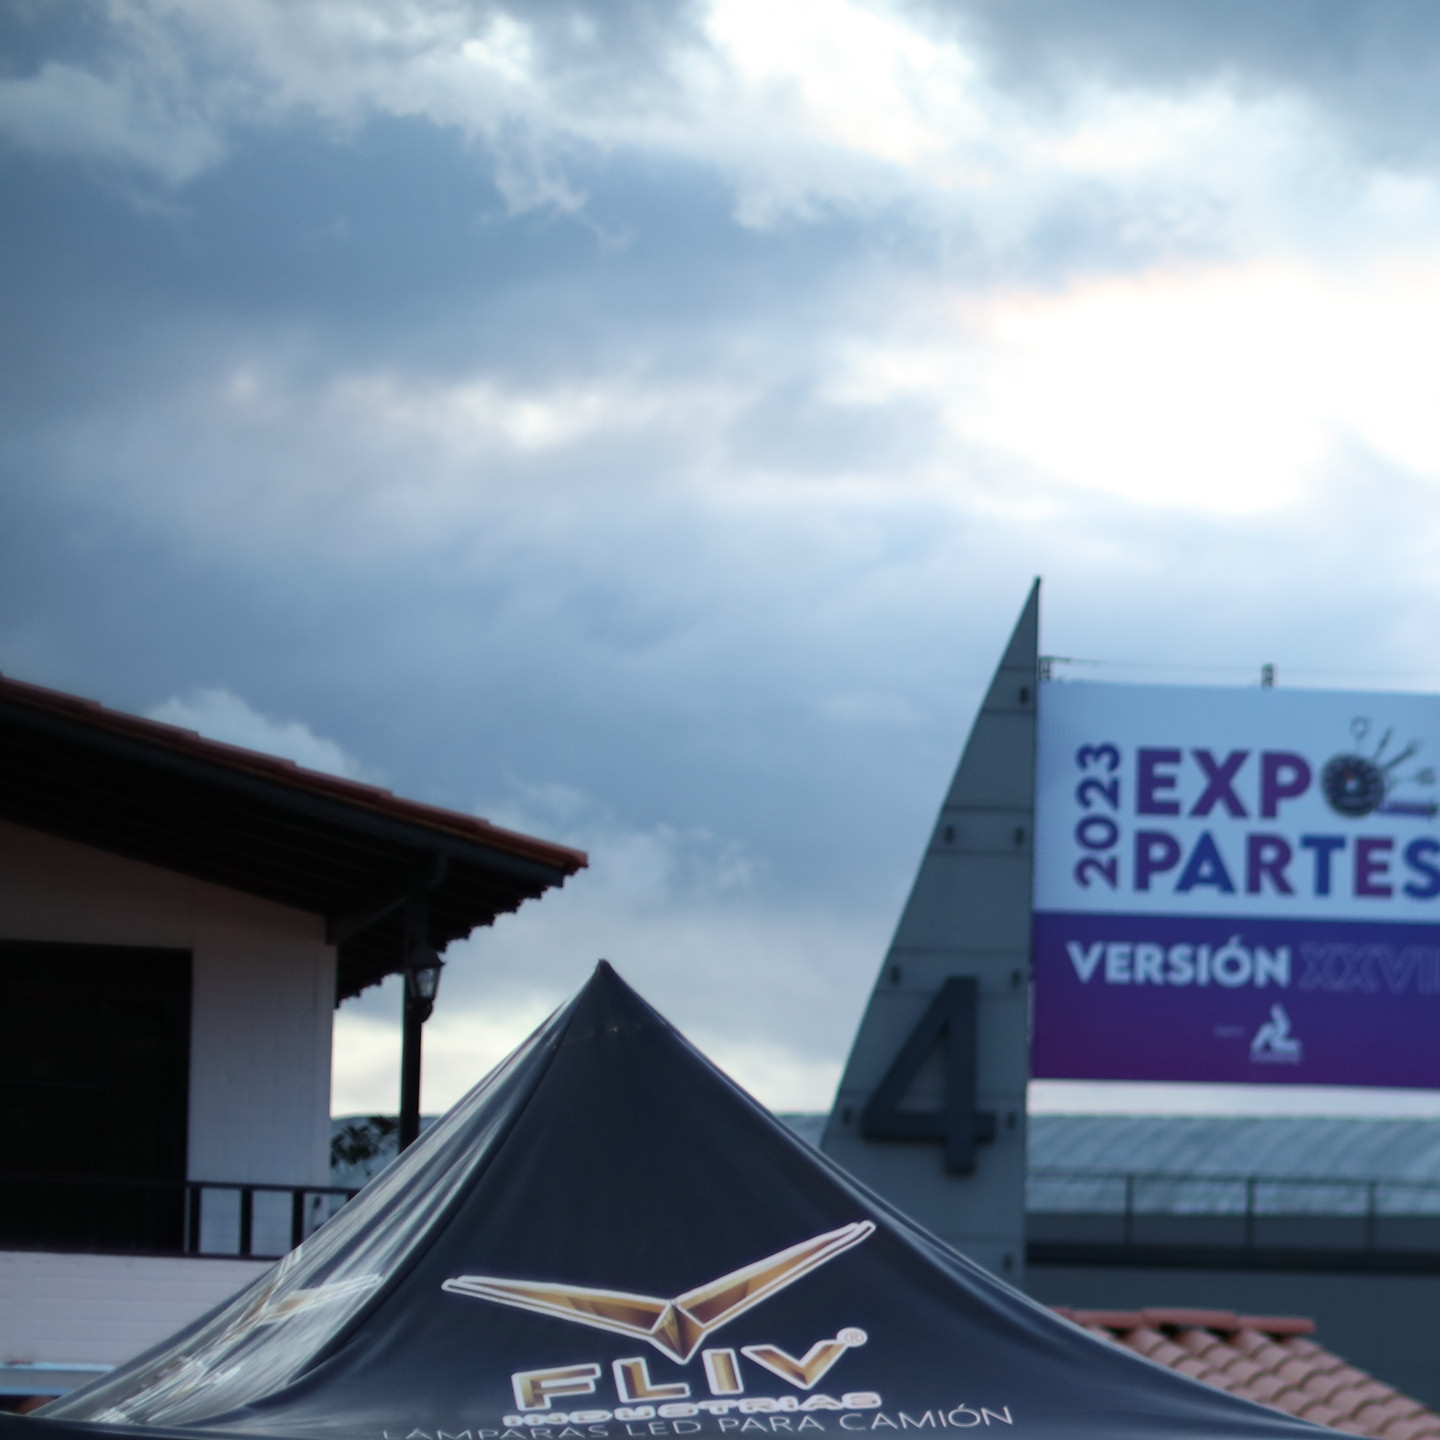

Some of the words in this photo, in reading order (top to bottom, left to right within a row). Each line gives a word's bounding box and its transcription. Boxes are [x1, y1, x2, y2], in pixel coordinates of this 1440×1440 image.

[1075, 741, 1122, 890] 2023
[1065, 934, 1293, 989] VERSIÓN
[858, 974, 998, 1178] 4
[501, 1391, 882, 1427] INDUSTRIAS
[625, 1415, 702, 1438] LED
[718, 1414, 826, 1433] PARA
[838, 1402, 1014, 1431] CAMIÓN
